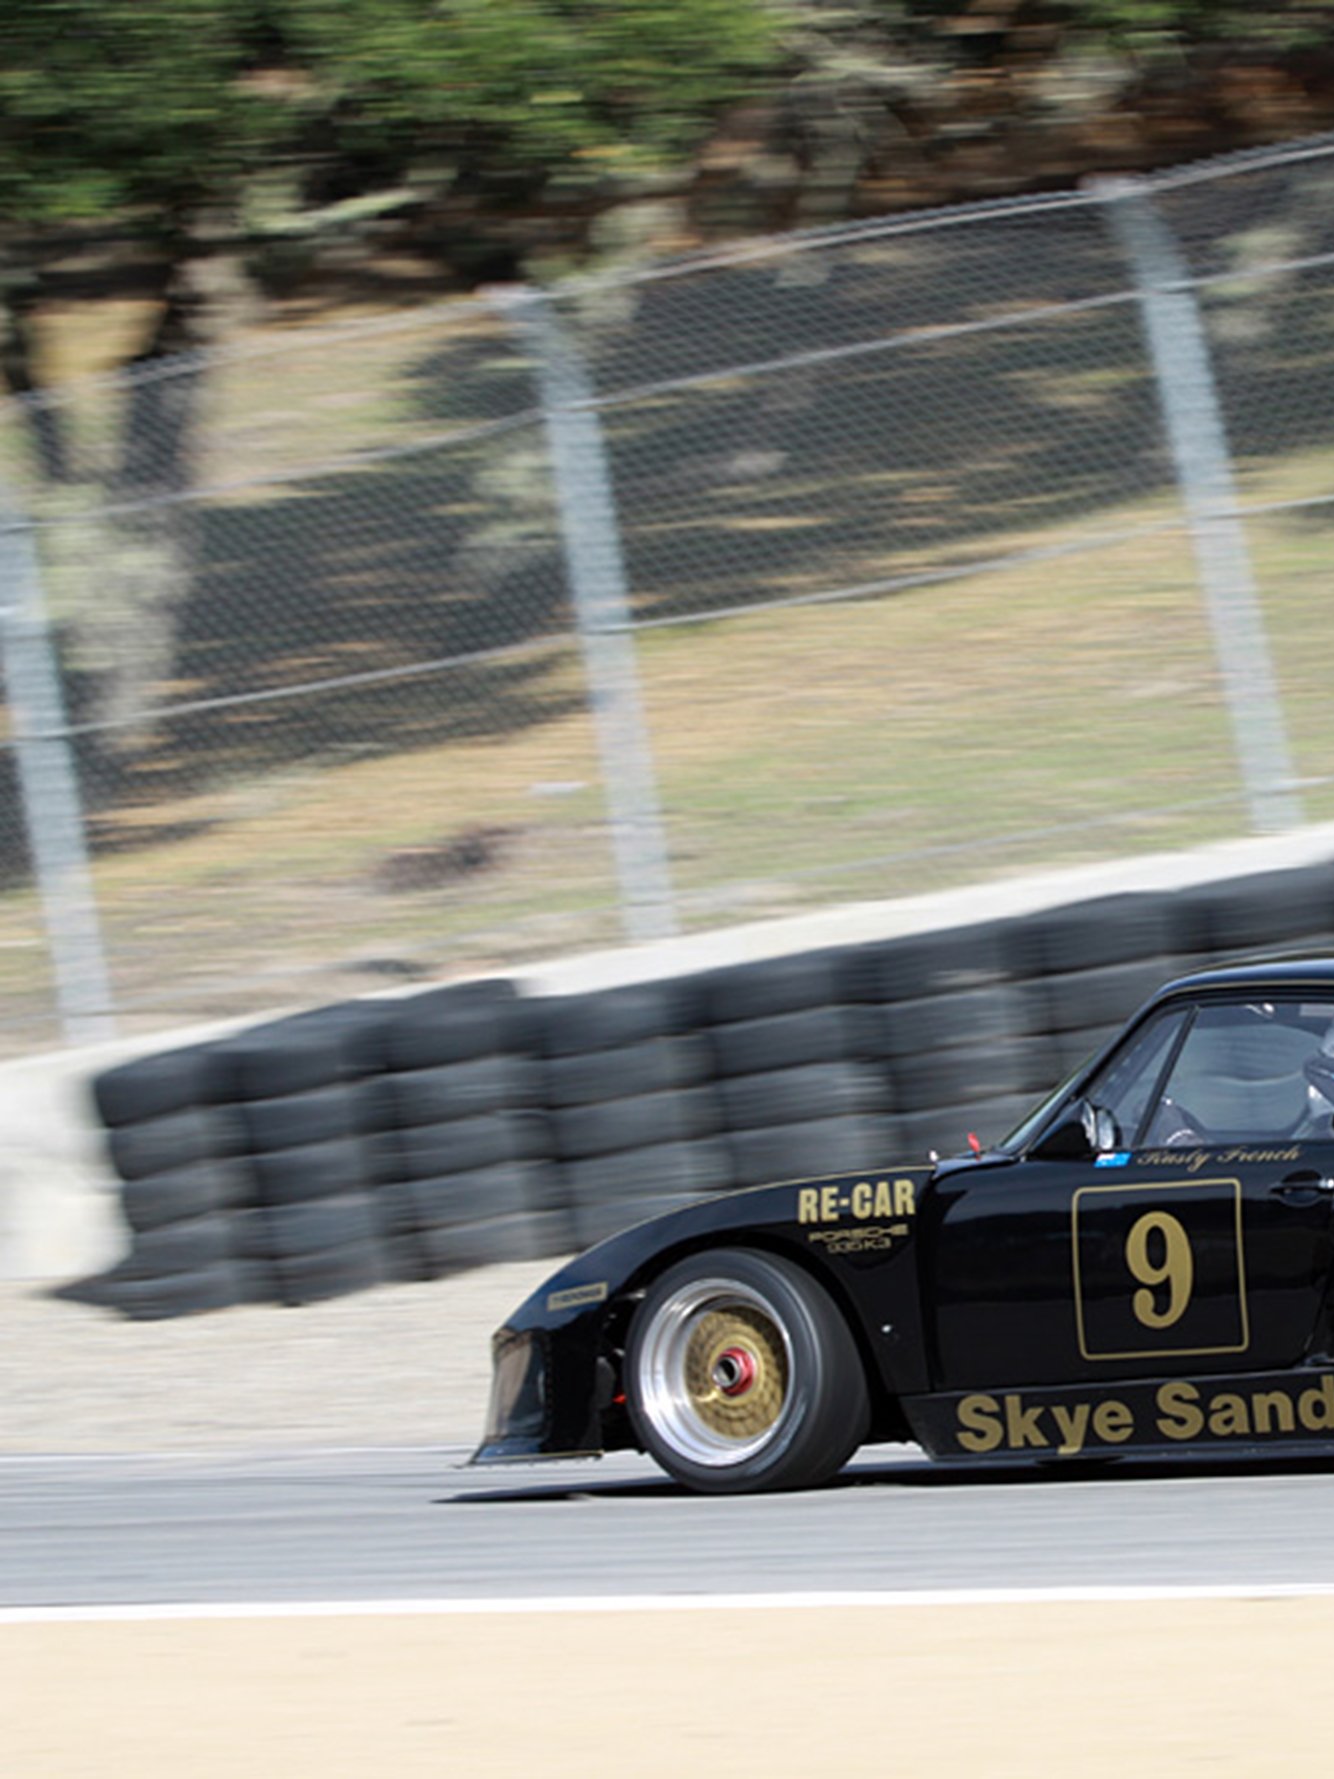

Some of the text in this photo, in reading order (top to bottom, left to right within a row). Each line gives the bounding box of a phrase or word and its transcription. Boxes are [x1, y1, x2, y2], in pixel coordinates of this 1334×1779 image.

[798, 1180, 916, 1223] RE-CAR
[1125, 1210, 1194, 1330] 9
[956, 1393, 1135, 1455] Skye
